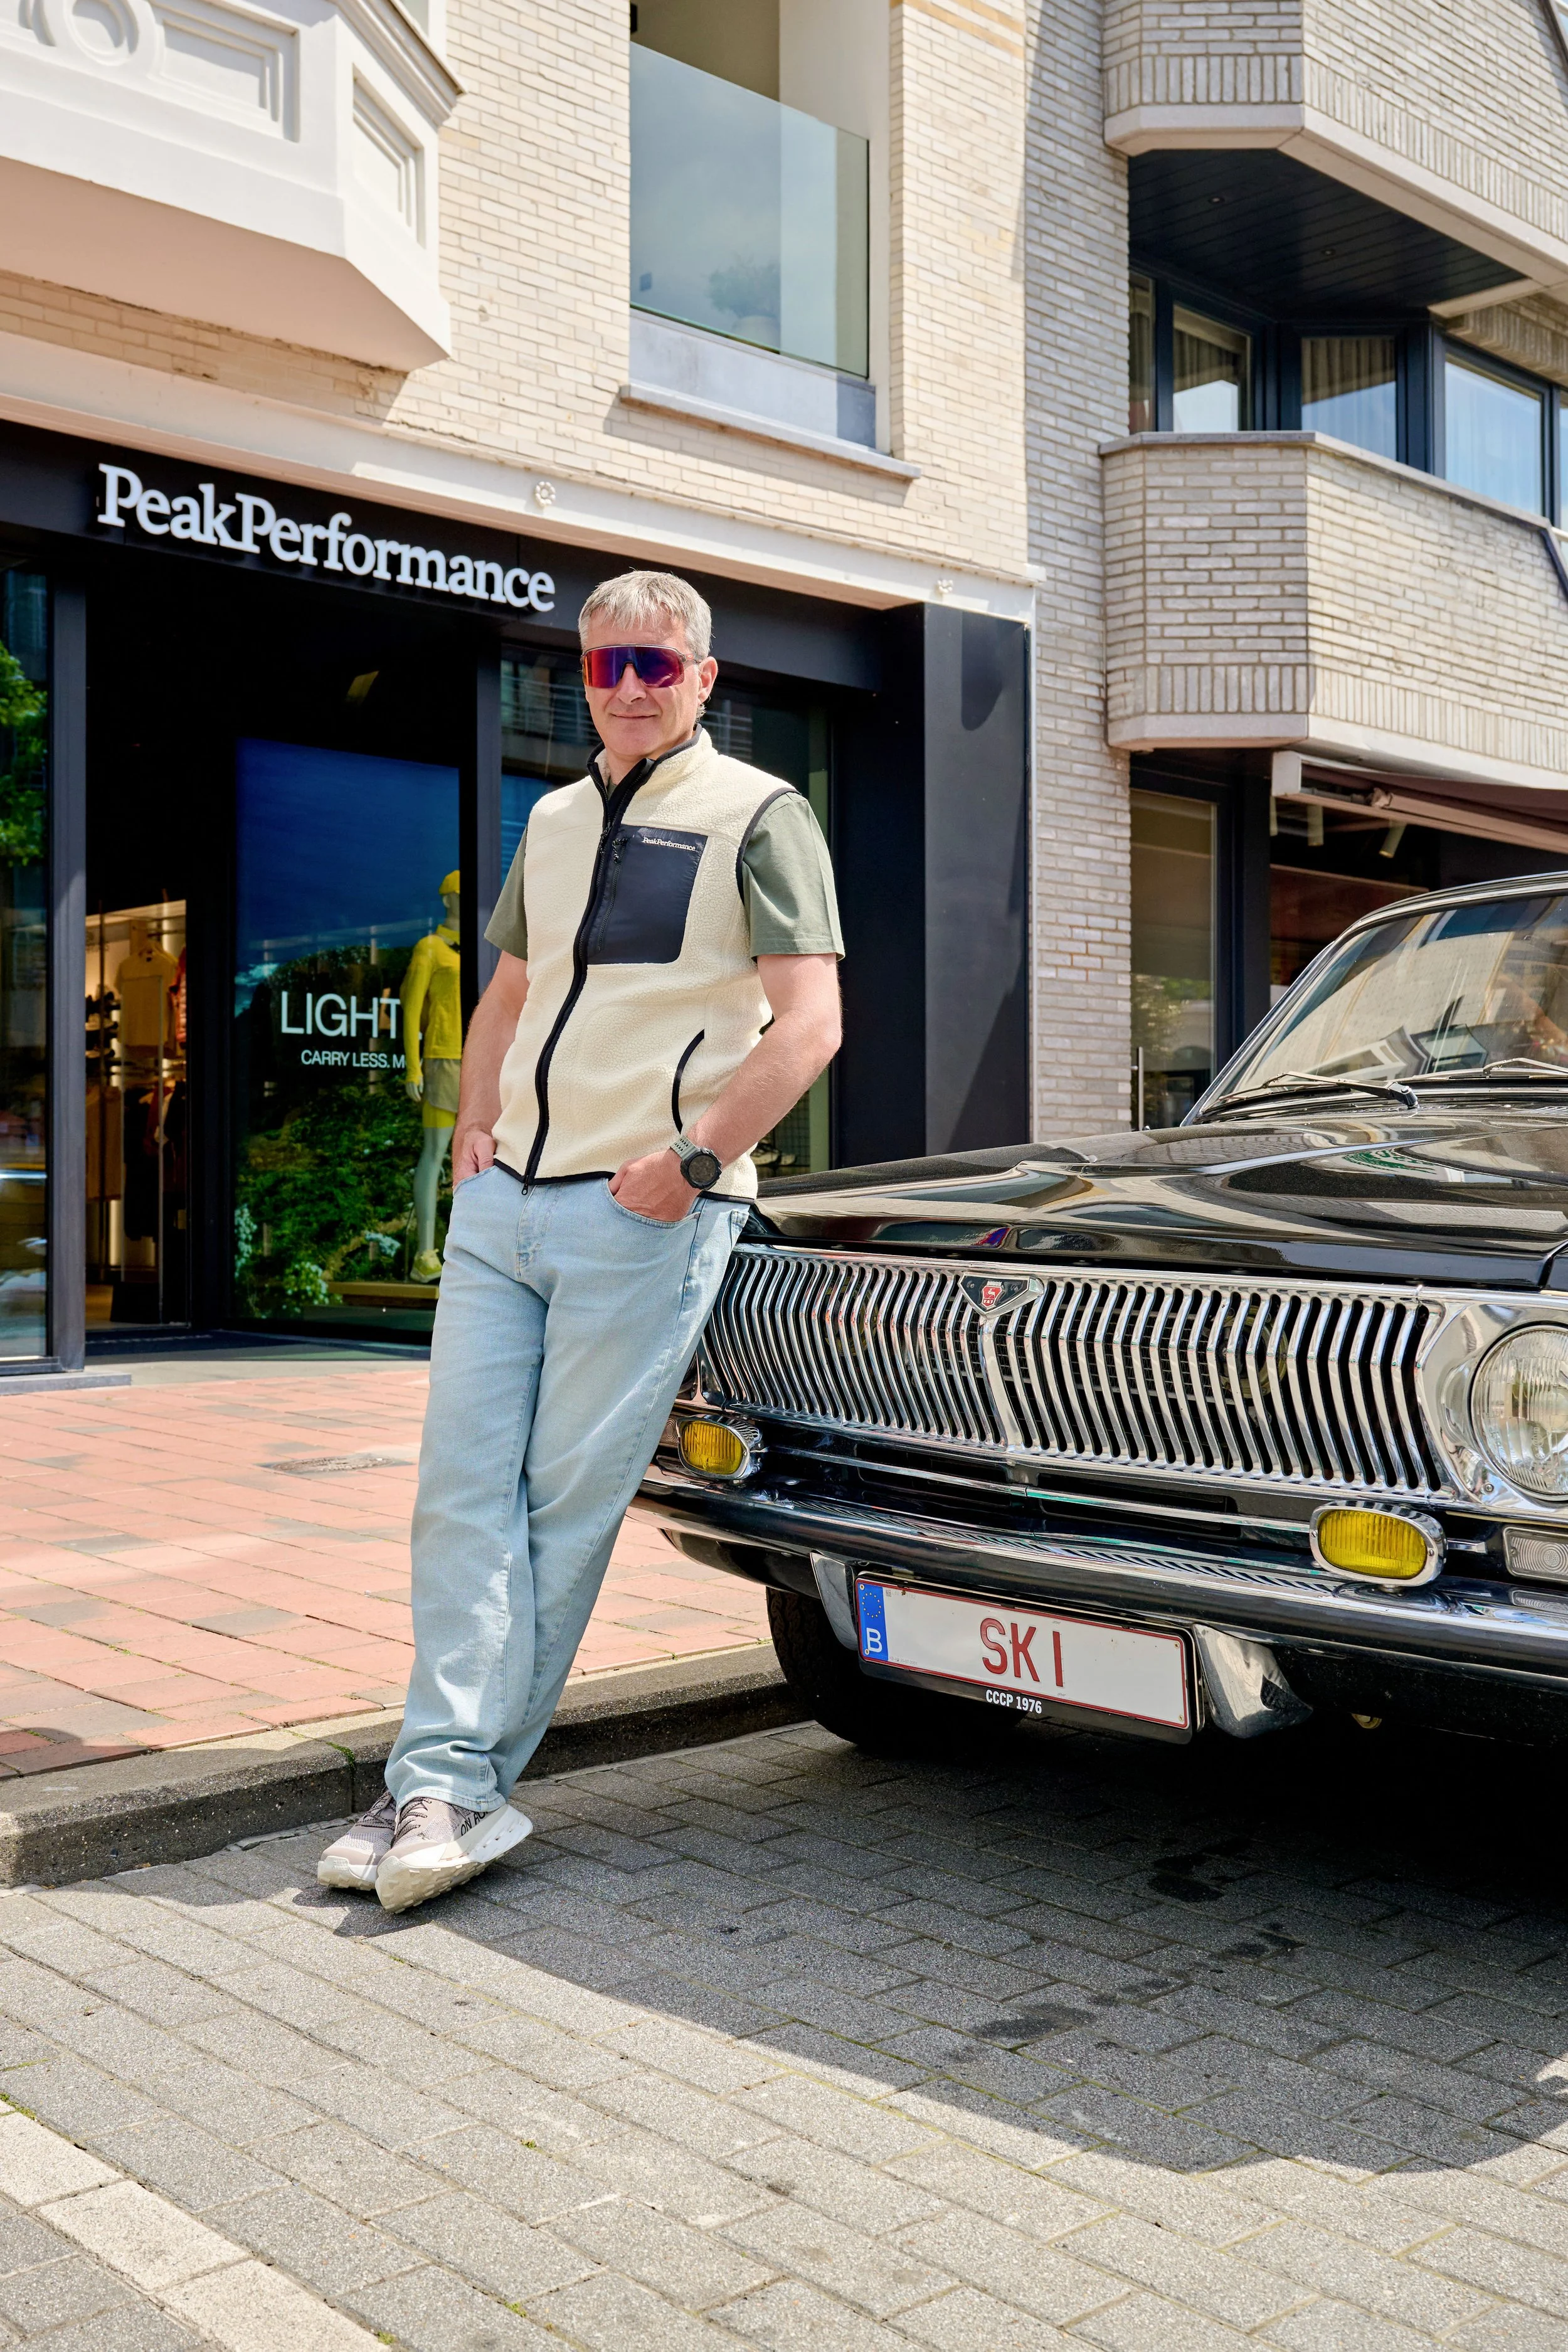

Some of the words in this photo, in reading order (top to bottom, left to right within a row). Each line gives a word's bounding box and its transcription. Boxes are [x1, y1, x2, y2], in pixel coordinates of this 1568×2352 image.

[97, 464, 556, 612] PeakPerformance
[642, 837, 696, 851] PeakPerformance
[301, 1049, 350, 1066] CARRY
[352, 1052, 391, 1069] LESS.
[866, 1628, 882, 1653] B
[980, 1618, 1064, 1687] SKI
[1015, 1696, 1042, 1714] 1976
[460, 1817, 472, 1836] ON
